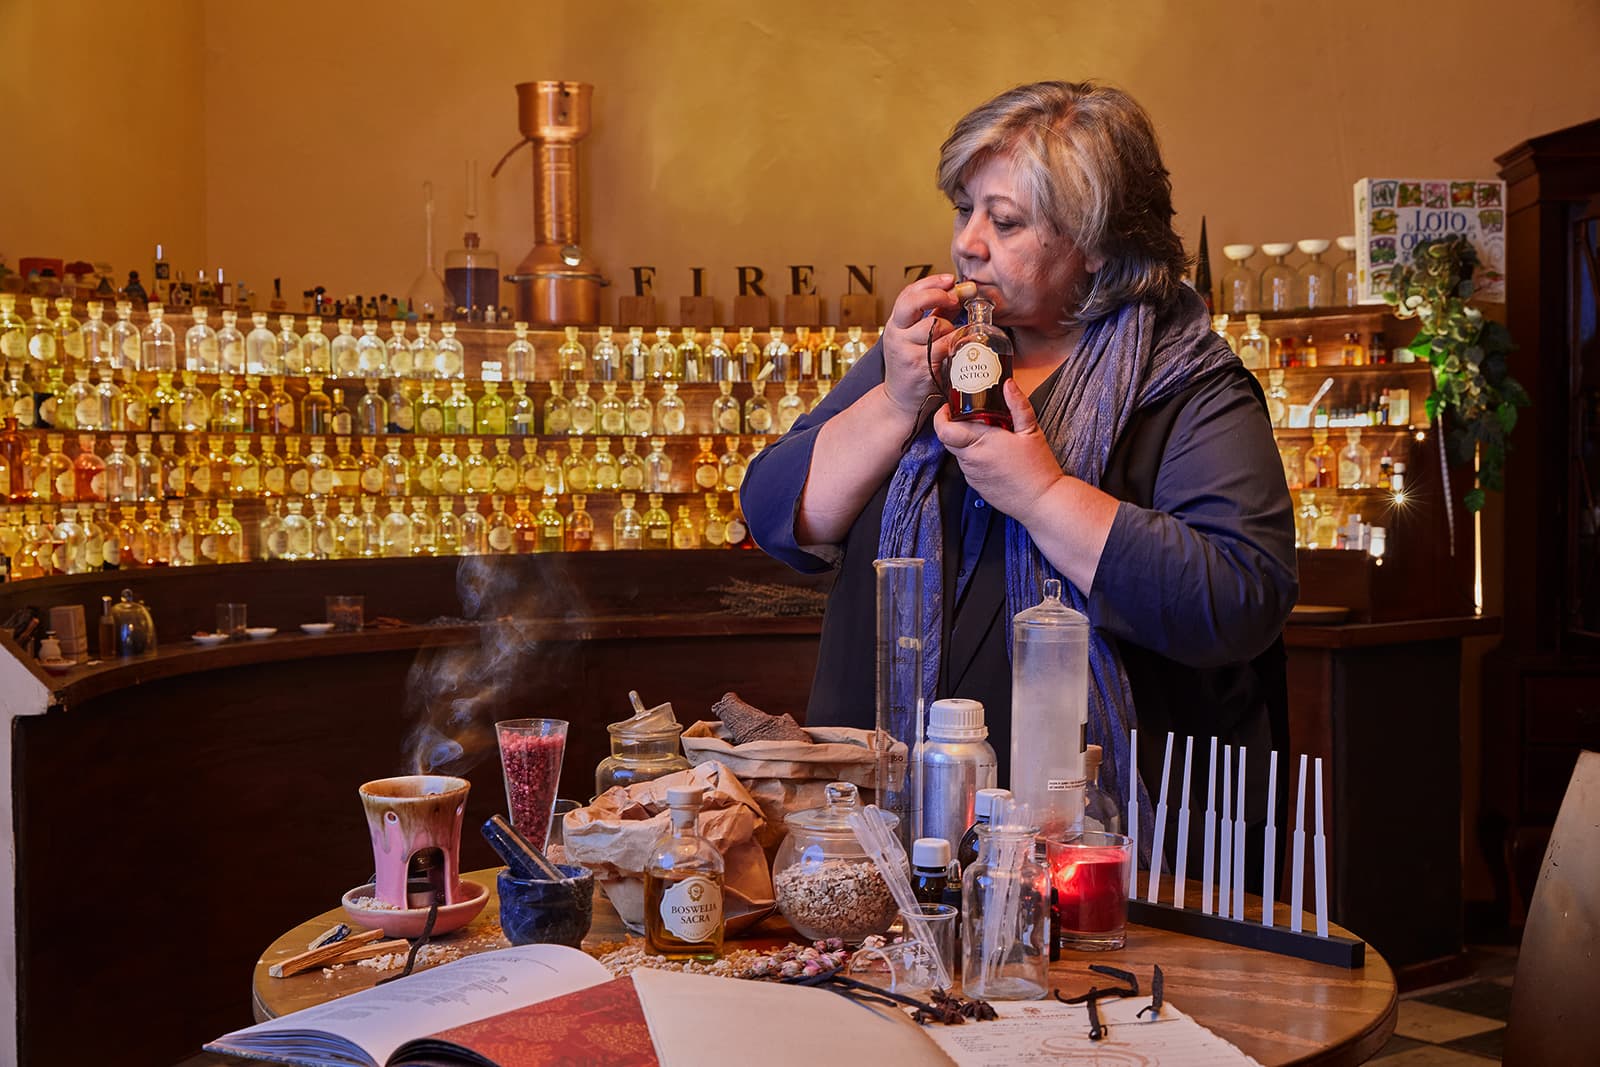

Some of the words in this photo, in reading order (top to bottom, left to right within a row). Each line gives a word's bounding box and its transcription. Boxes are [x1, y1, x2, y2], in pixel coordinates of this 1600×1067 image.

[960, 364, 987, 372] CUOIO
[959, 371, 989, 381] ANTICO
[680, 914, 711, 924] SACRA
